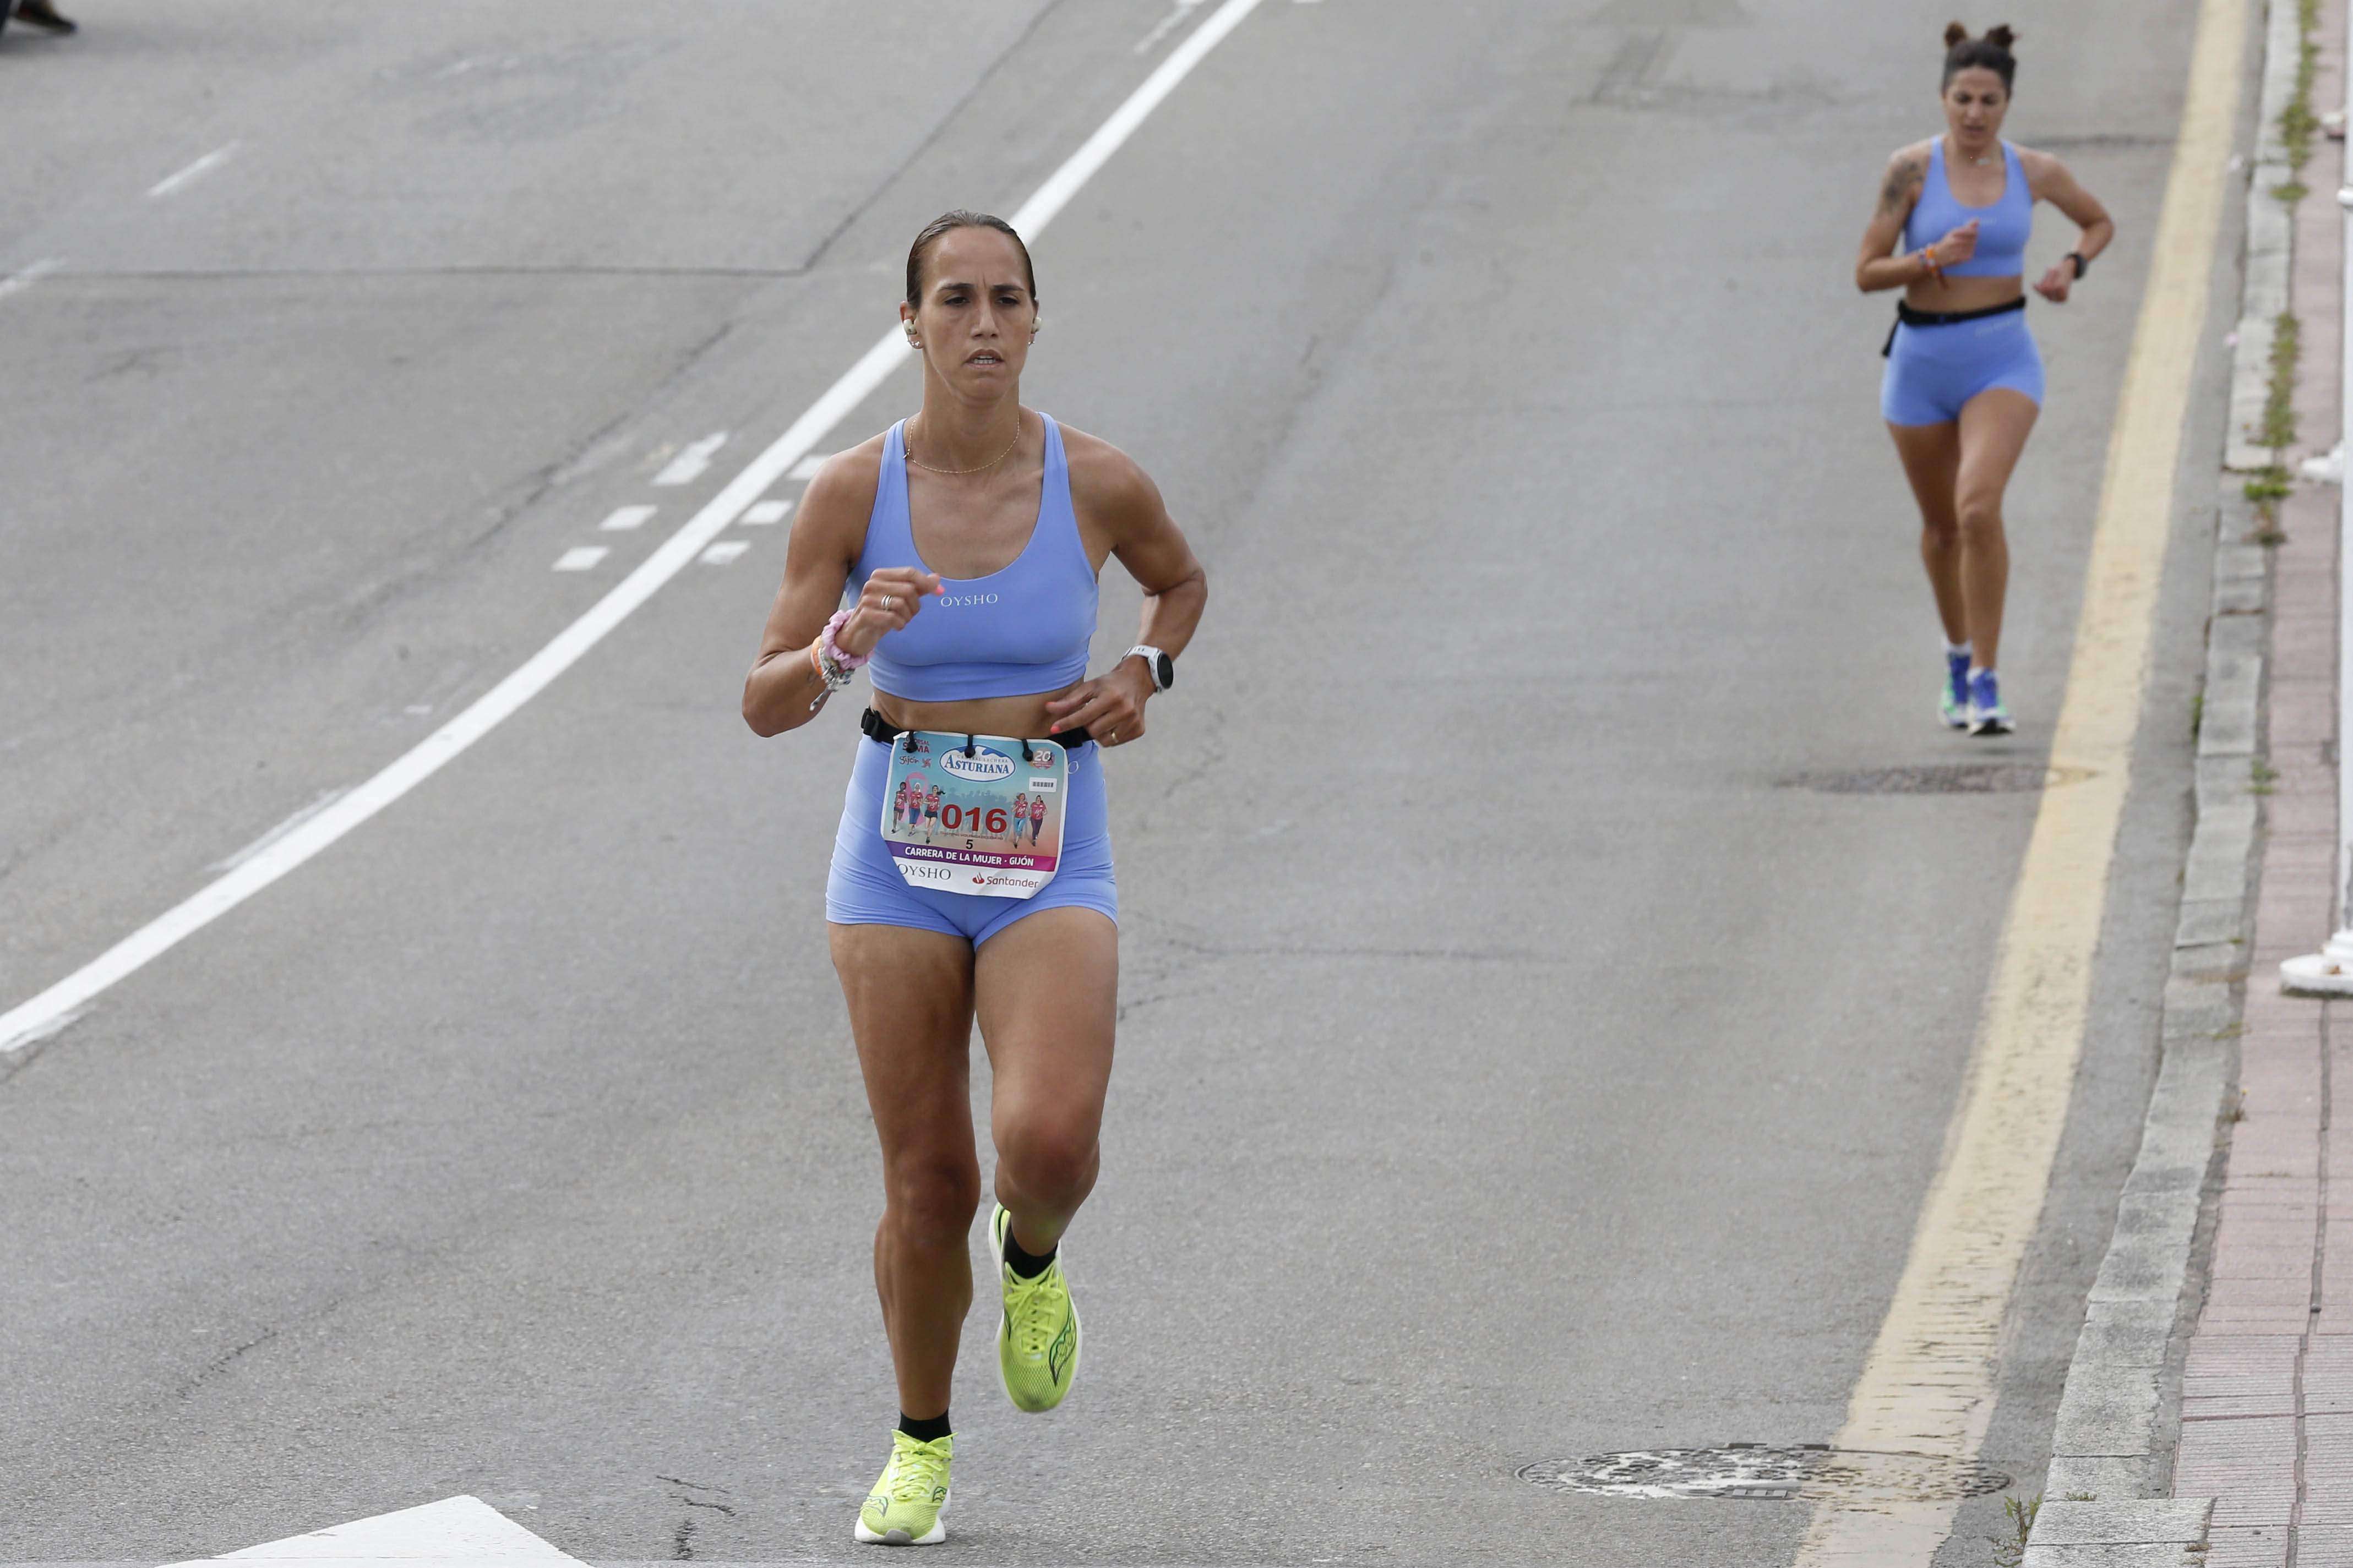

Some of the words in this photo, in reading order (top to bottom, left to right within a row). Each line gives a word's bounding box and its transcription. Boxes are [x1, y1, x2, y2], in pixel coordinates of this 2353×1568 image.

[940, 594, 998, 607] OYSHO
[903, 744, 929, 753] SMA
[1034, 750, 1051, 762] 20
[941, 804, 1007, 833] 016
[966, 839, 973, 850] 5
[905, 846, 944, 859] CARRERA
[946, 852, 957, 860] DE
[959, 853, 971, 862] LA
[973, 854, 1002, 865] MUJER
[1009, 855, 1034, 866] GIJÓN
[897, 863, 951, 881] OYSHO
[986, 876, 1039, 888] Santander
